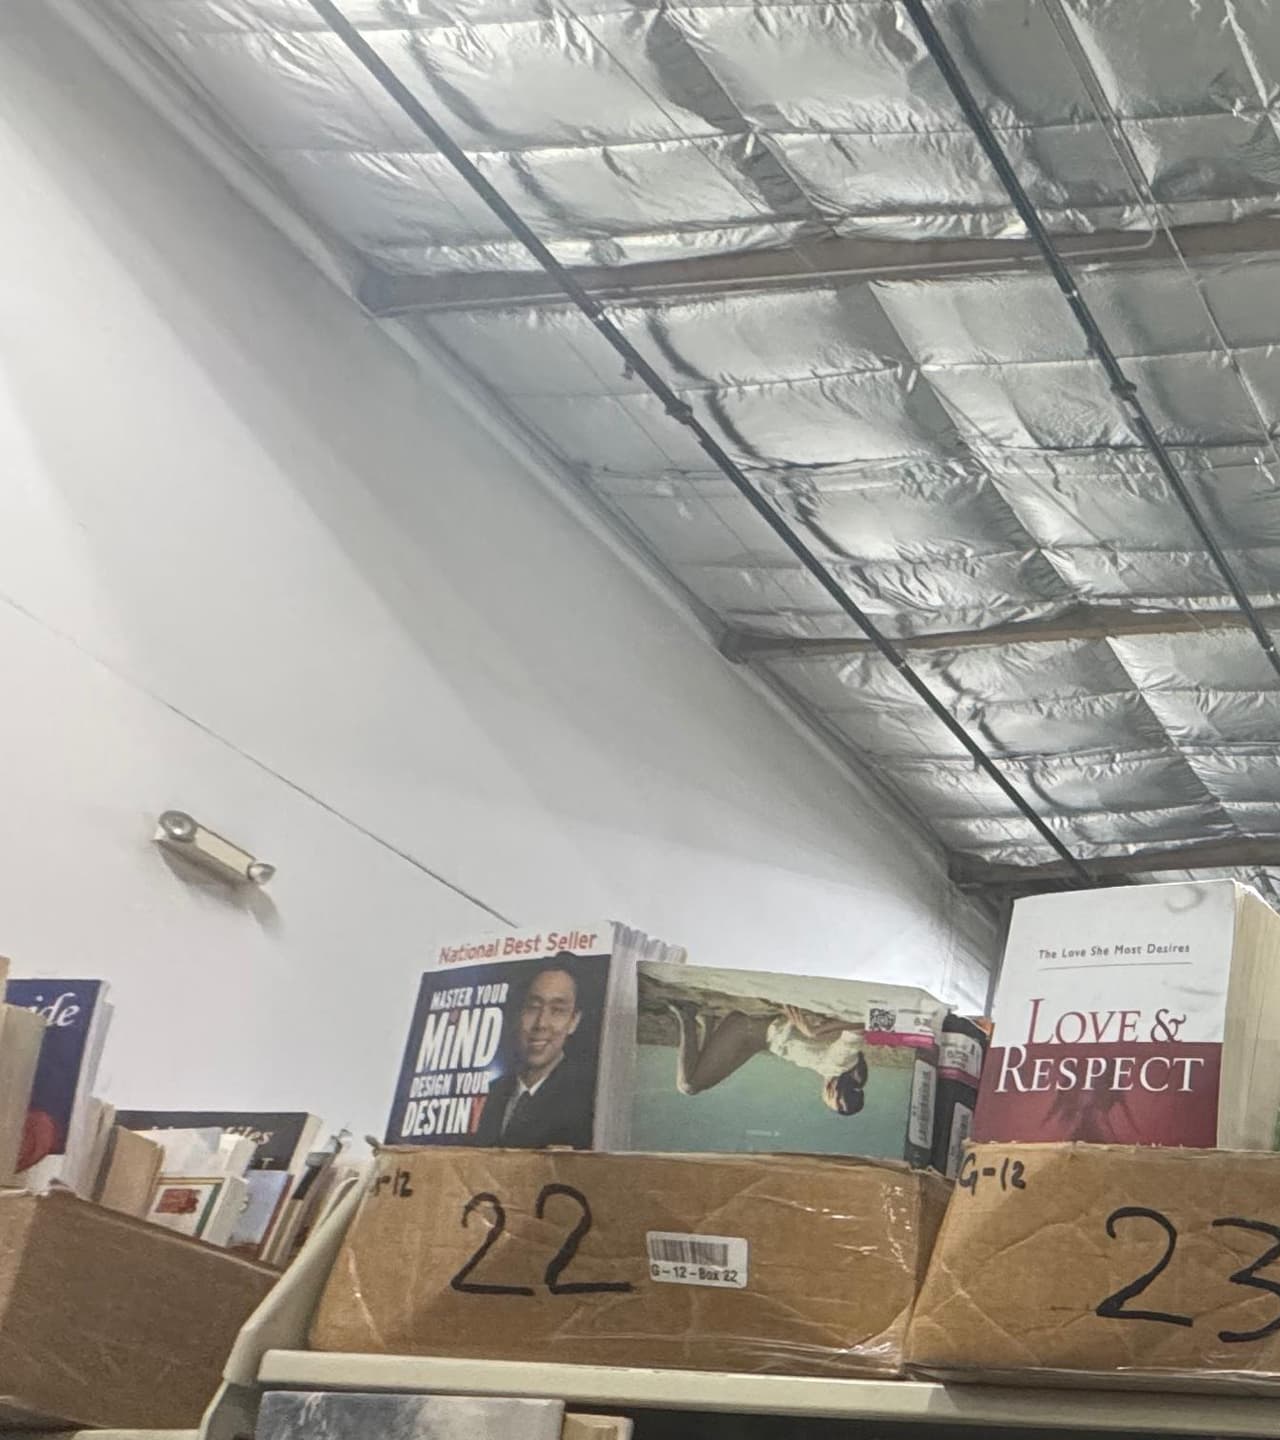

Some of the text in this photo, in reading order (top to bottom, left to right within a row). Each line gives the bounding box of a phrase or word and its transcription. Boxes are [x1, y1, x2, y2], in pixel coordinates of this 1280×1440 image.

[439, 930, 598, 964] National Best Seller
[1039, 943, 1191, 960] The Love She Most Desires
[431, 983, 509, 1008] MASTER YOUR
[1027, 998, 1187, 1046] LOVE &
[994, 1044, 1204, 1094] RESPECT
[409, 1072, 491, 1098] DESIGN YOUR
[450, 1183, 636, 1296] 22
[720, 1268, 740, 1284] 22
